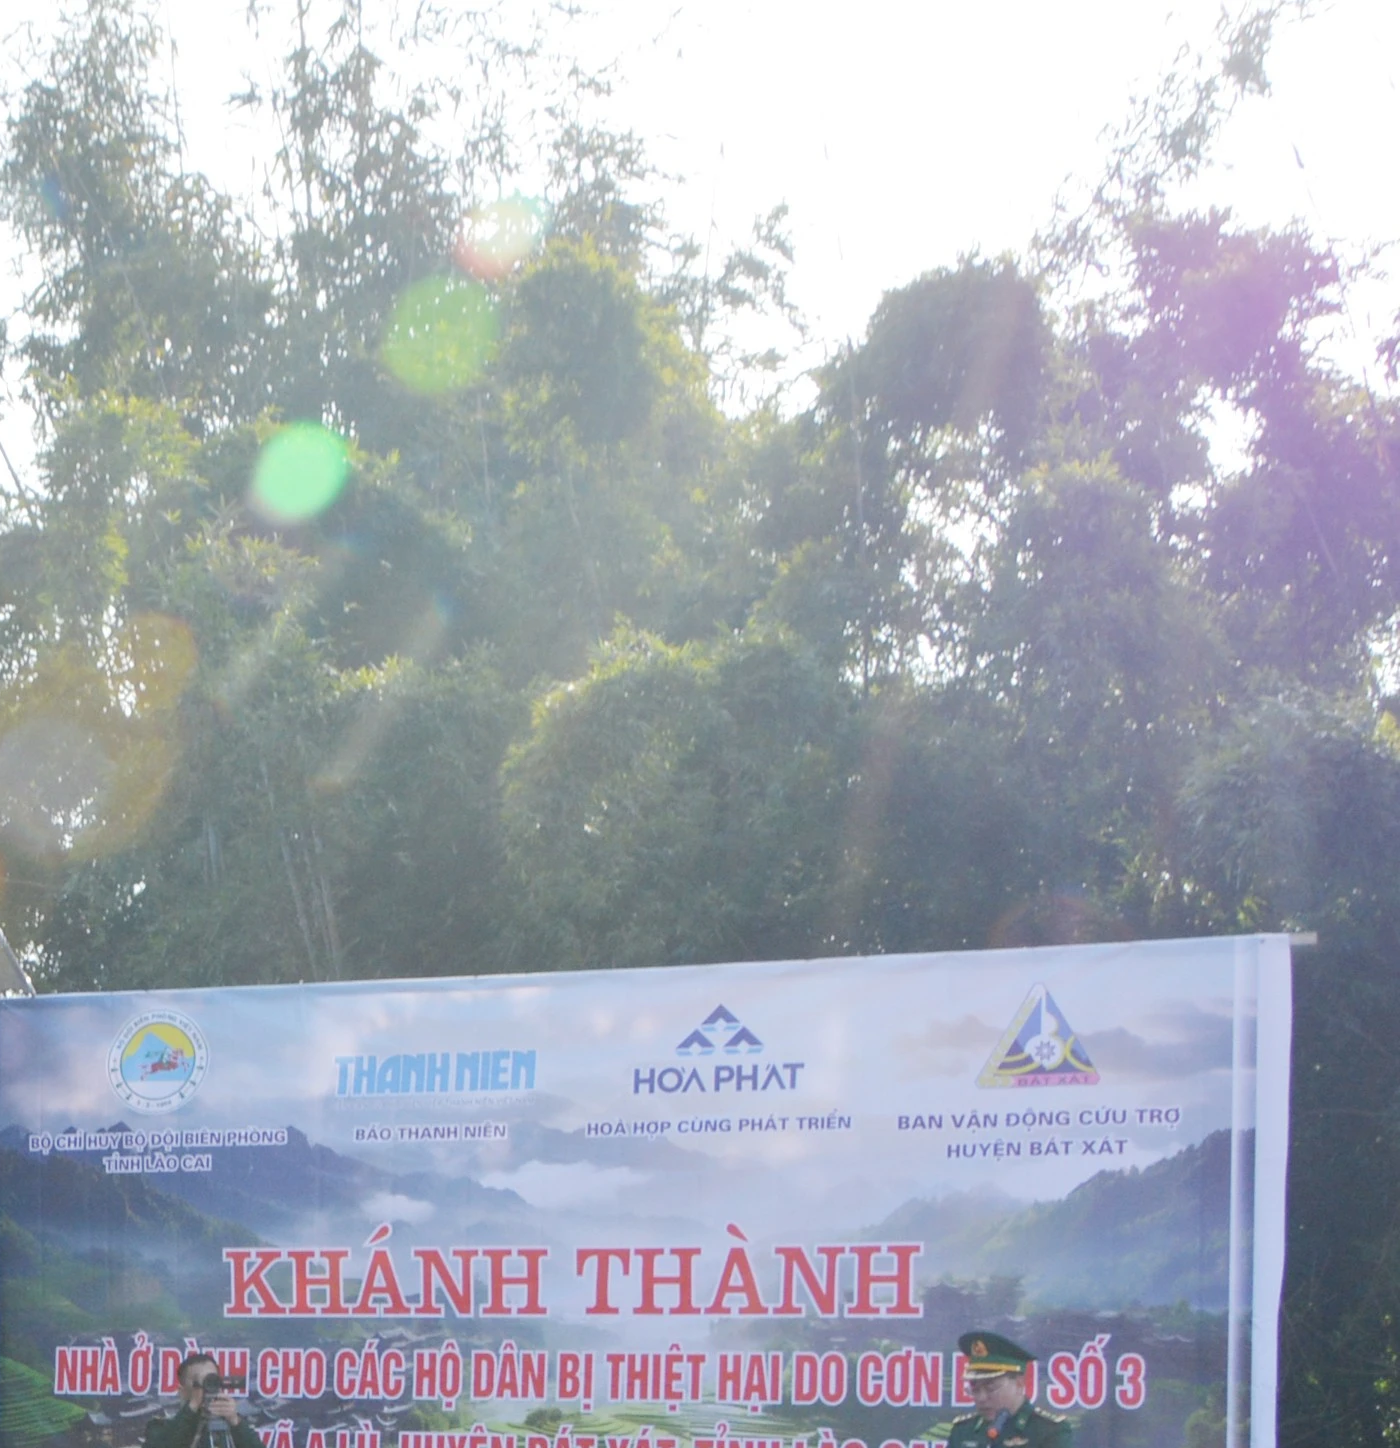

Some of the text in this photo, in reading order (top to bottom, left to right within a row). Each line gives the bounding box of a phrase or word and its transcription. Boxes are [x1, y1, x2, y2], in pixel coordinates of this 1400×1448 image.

[335, 1054, 450, 1095] THANH
[714, 1063, 805, 1092] PHÁT
[354, 1120, 507, 1141] BÁO THANH NIÊN
[633, 1120, 671, 1140] HỢP
[677, 1115, 732, 1134] CÙNG
[738, 1113, 790, 1132] PHÁT
[796, 1108, 852, 1130] TRIỂN
[897, 1105, 1181, 1134] BAN VẬN ĐỘNG CỨU TRỢ
[31, 1133, 52, 1153] BỘ
[56, 1130, 84, 1150] CHỈ
[88, 1134, 121, 1150] HUY
[124, 1131, 147, 1151] BỘ
[184, 1127, 222, 1147] BIÊN
[227, 1126, 287, 1146] PHÒNG
[947, 1135, 1128, 1162] HUYỆN BÁT XÁT
[104, 1152, 212, 1172] TỈNH LÀO CAI
[224, 1223, 922, 1316] KHÁNH THÀNH
[57, 1337, 121, 1394] NHÀ
[129, 1332, 153, 1394] Ở
[258, 1349, 326, 1398] CHO
[336, 1340, 404, 1398] CÁC
[415, 1342, 461, 1410] HỘ
[473, 1342, 549, 1399] DÂN
[560, 1352, 593, 1410] BỊ
[606, 1344, 705, 1411] THIỆT
[718, 1353, 782, 1412] HẠI
[794, 1353, 846, 1404] DO
[857, 1347, 941, 1405] CƠN
[1049, 1334, 1109, 1407] SỐ
[1117, 1354, 1145, 1408] 3
